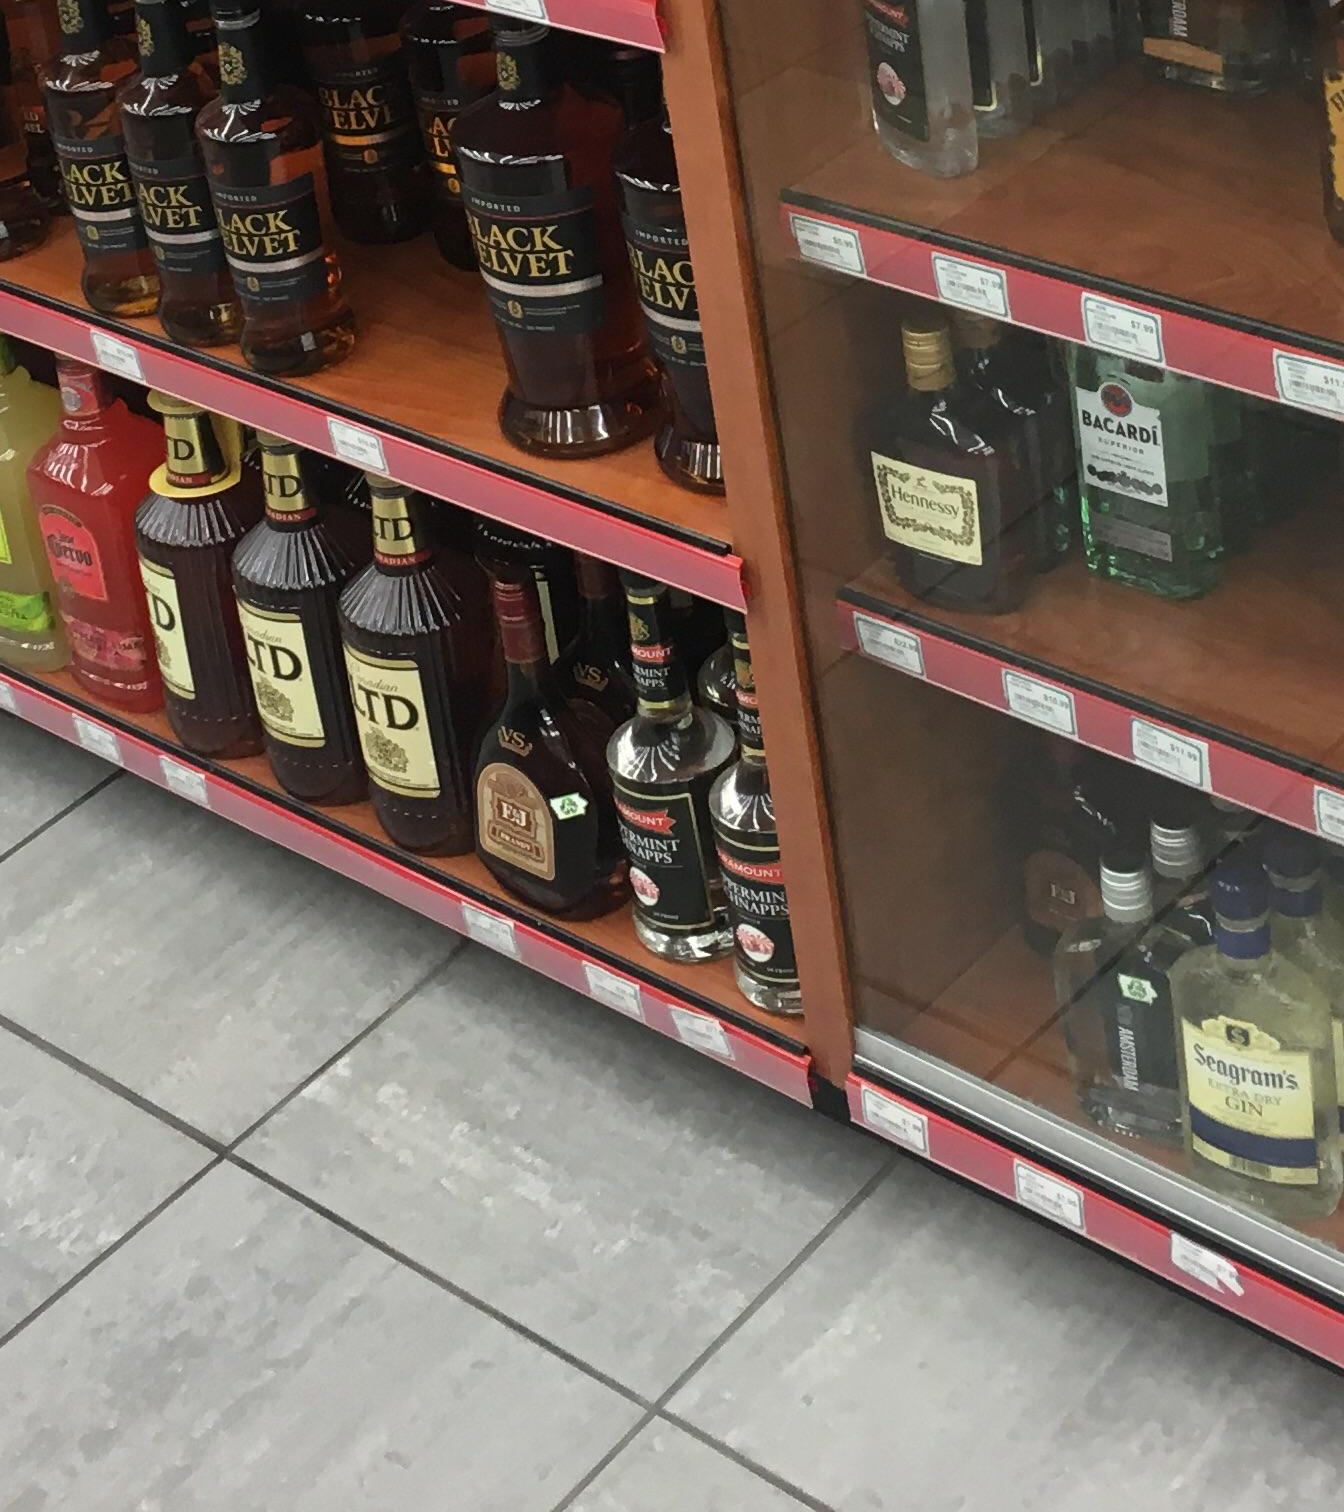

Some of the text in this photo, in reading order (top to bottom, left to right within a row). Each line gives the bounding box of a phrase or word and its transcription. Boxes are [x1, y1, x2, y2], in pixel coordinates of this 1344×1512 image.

[1098, 437, 1144, 454] SUPERIOR
[891, 482, 961, 520] Hennessy
[355, 690, 420, 731] LTD
[1193, 1040, 1299, 1093] Seagram's
[1223, 1093, 1265, 1118] GIN
